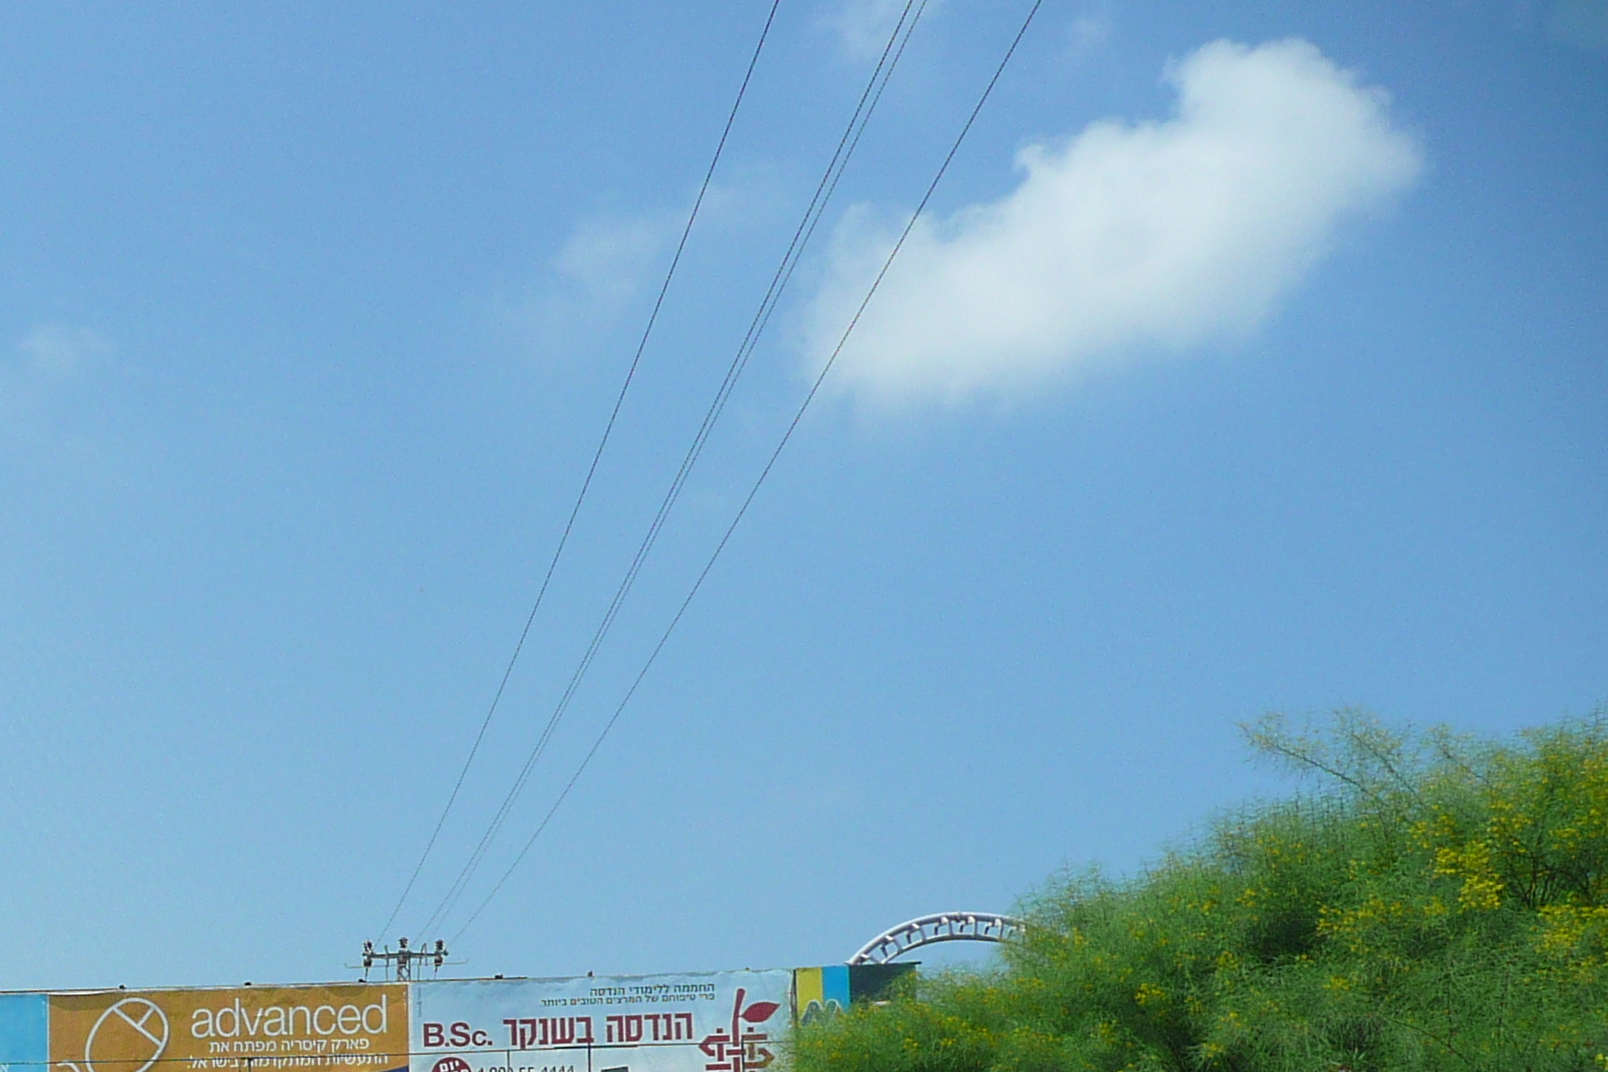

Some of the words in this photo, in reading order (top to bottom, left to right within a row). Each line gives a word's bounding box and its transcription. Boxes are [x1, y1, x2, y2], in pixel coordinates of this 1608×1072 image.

[590, 987, 626, 997] הנדסה
[629, 984, 669, 995] ללימודי
[674, 983, 715, 993] החממה
[645, 994, 659, 1003] של
[192, 994, 388, 1039] advanced
[503, 1017, 594, 1050] בשנקר
[606, 1013, 693, 1043] הנדסה
[423, 1022, 493, 1048] B.Sc.
[209, 1042, 231, 1053] את
[234, 1040, 277, 1053] מפתח
[281, 1039, 328, 1053] קיסריה
[331, 1038, 370, 1053] פארק
[439, 1060, 459, 1072] יום
